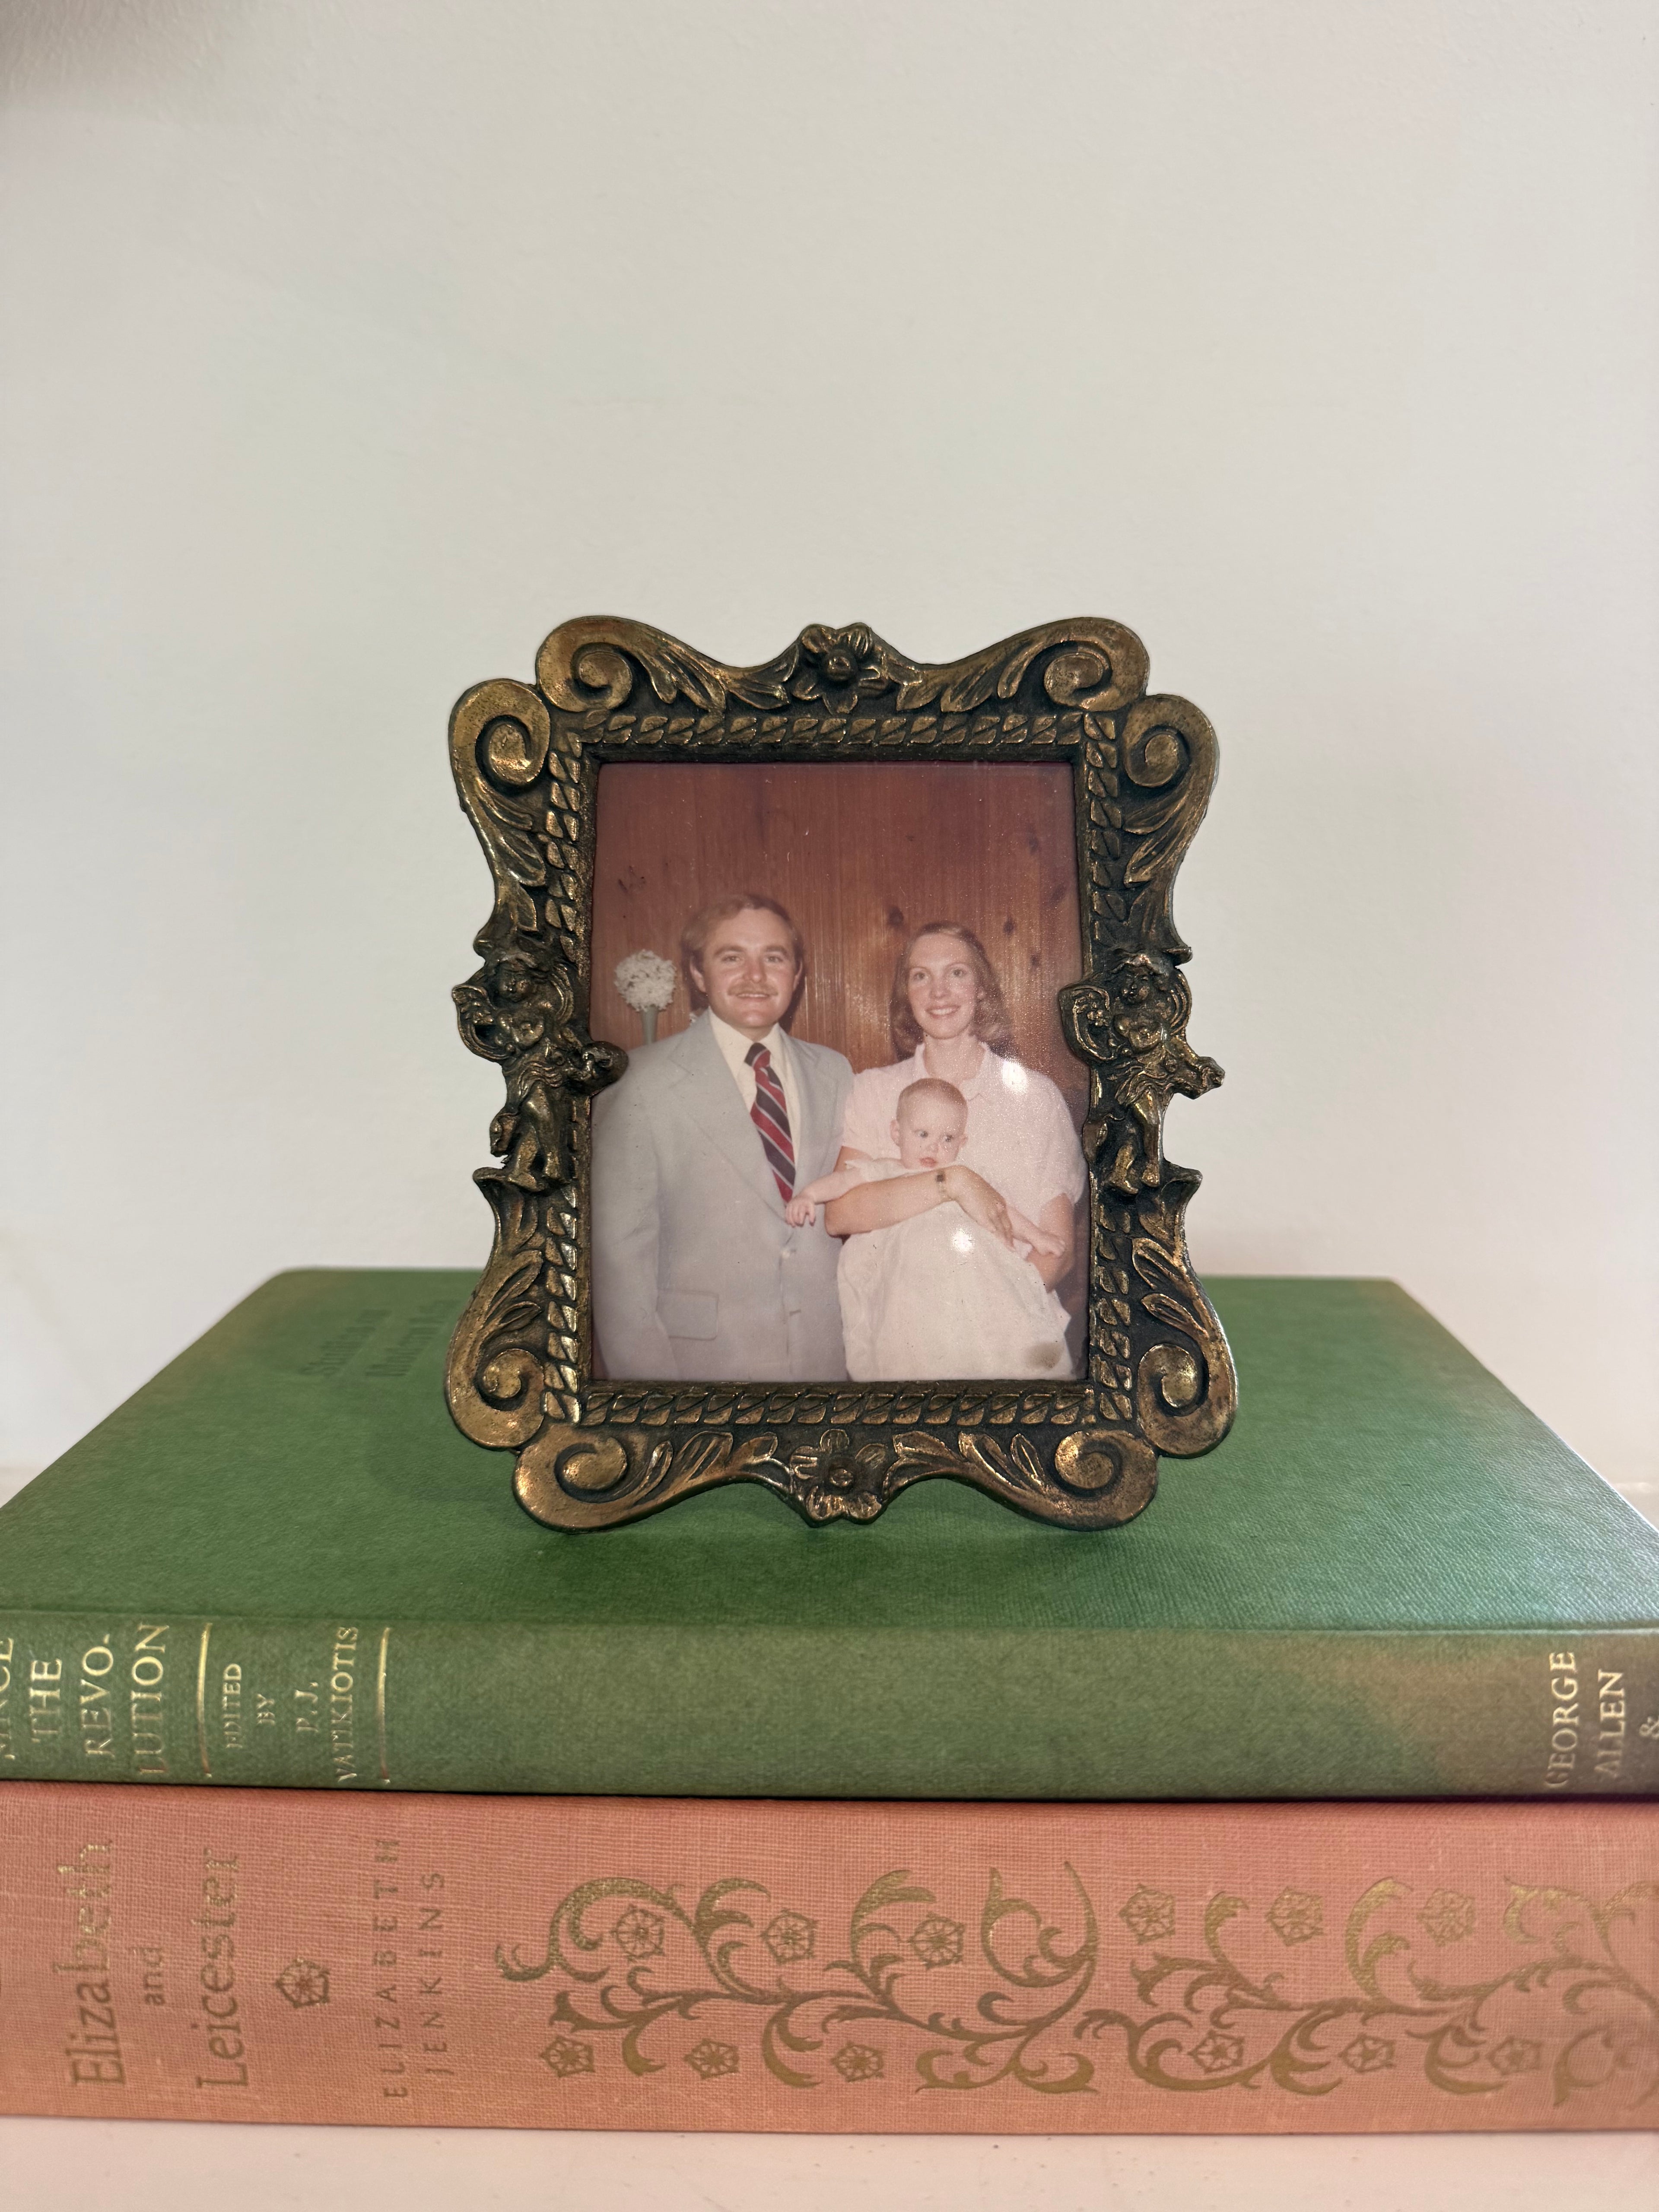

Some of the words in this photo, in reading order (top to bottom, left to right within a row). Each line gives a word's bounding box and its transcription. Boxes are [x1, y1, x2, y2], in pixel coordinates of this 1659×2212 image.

[29, 1658, 62, 1743] THE
[222, 1663, 243, 1749] EDITED
[256, 1693, 276, 1726] BY
[331, 1627, 359, 1783] VATIKIOTIS
[1544, 1651, 1580, 1788] GEORGE
[1594, 1669, 1627, 1777] ALLEN
[52, 1839, 126, 2087] Elizabeth
[132, 1946, 166, 2006] and
[190, 1847, 249, 2088] Leicester
[372, 1839, 409, 2098] ELIZABETH
[419, 1872, 454, 2075] JENKINS
